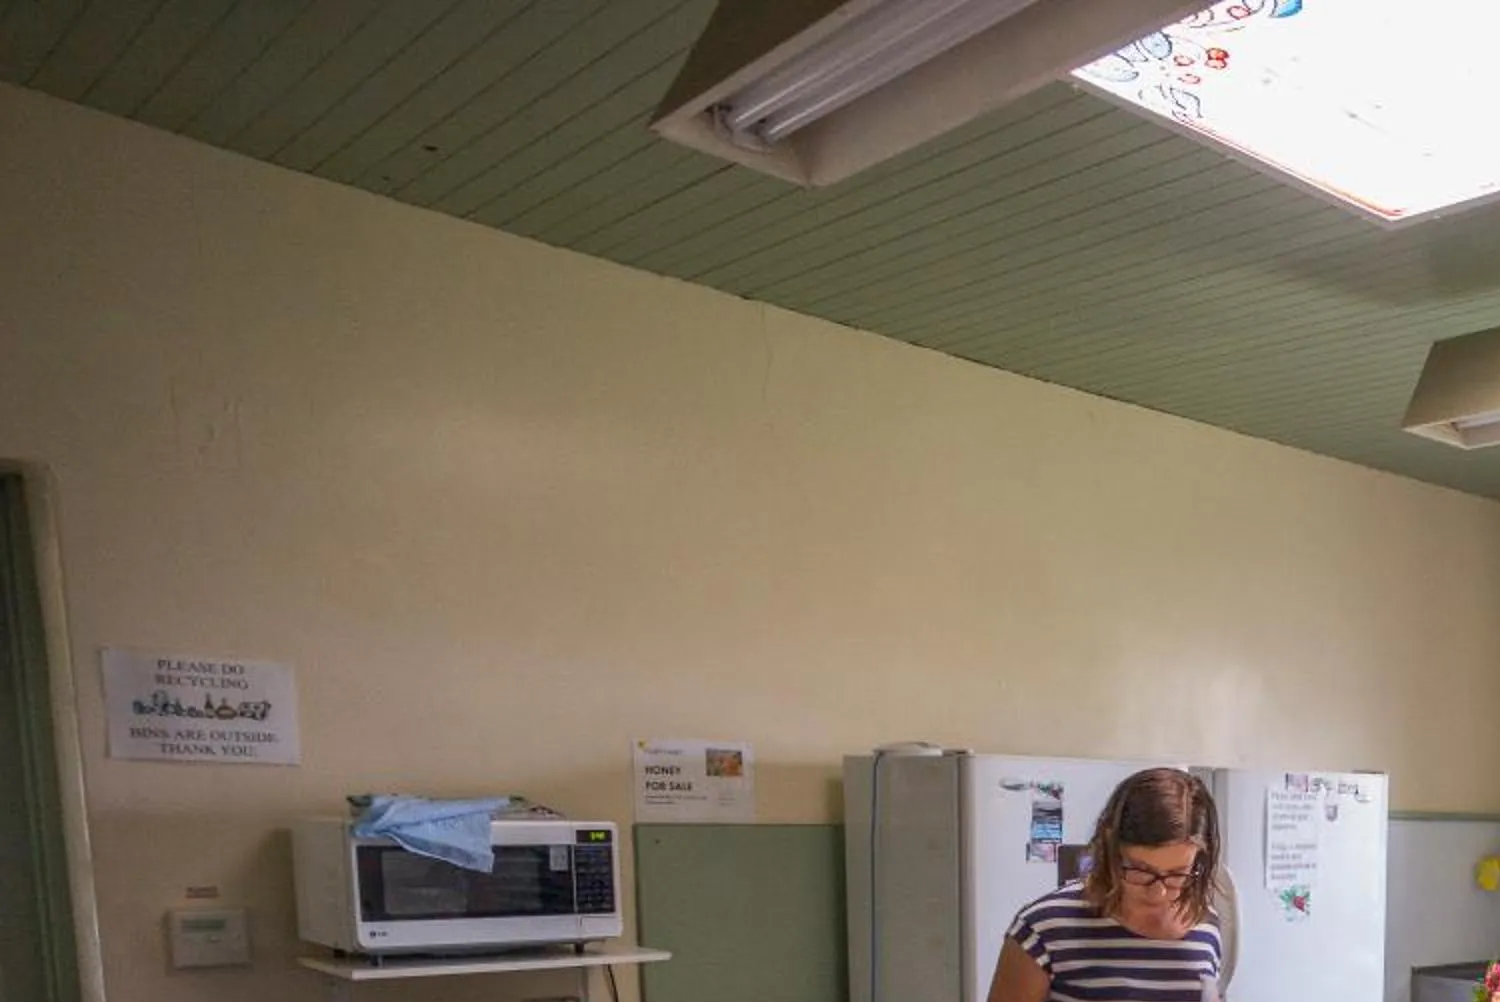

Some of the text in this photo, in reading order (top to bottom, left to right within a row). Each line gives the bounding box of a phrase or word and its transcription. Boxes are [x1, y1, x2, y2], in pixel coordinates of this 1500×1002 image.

[157, 659, 245, 676] PLEASE DO
[155, 674, 249, 690] RECYCLING
[129, 727, 170, 740] BINS
[174, 729, 207, 742] ARE
[160, 743, 216, 756] THANK
[644, 765, 681, 776] HONEY
[645, 781, 693, 792] FOR SALE
